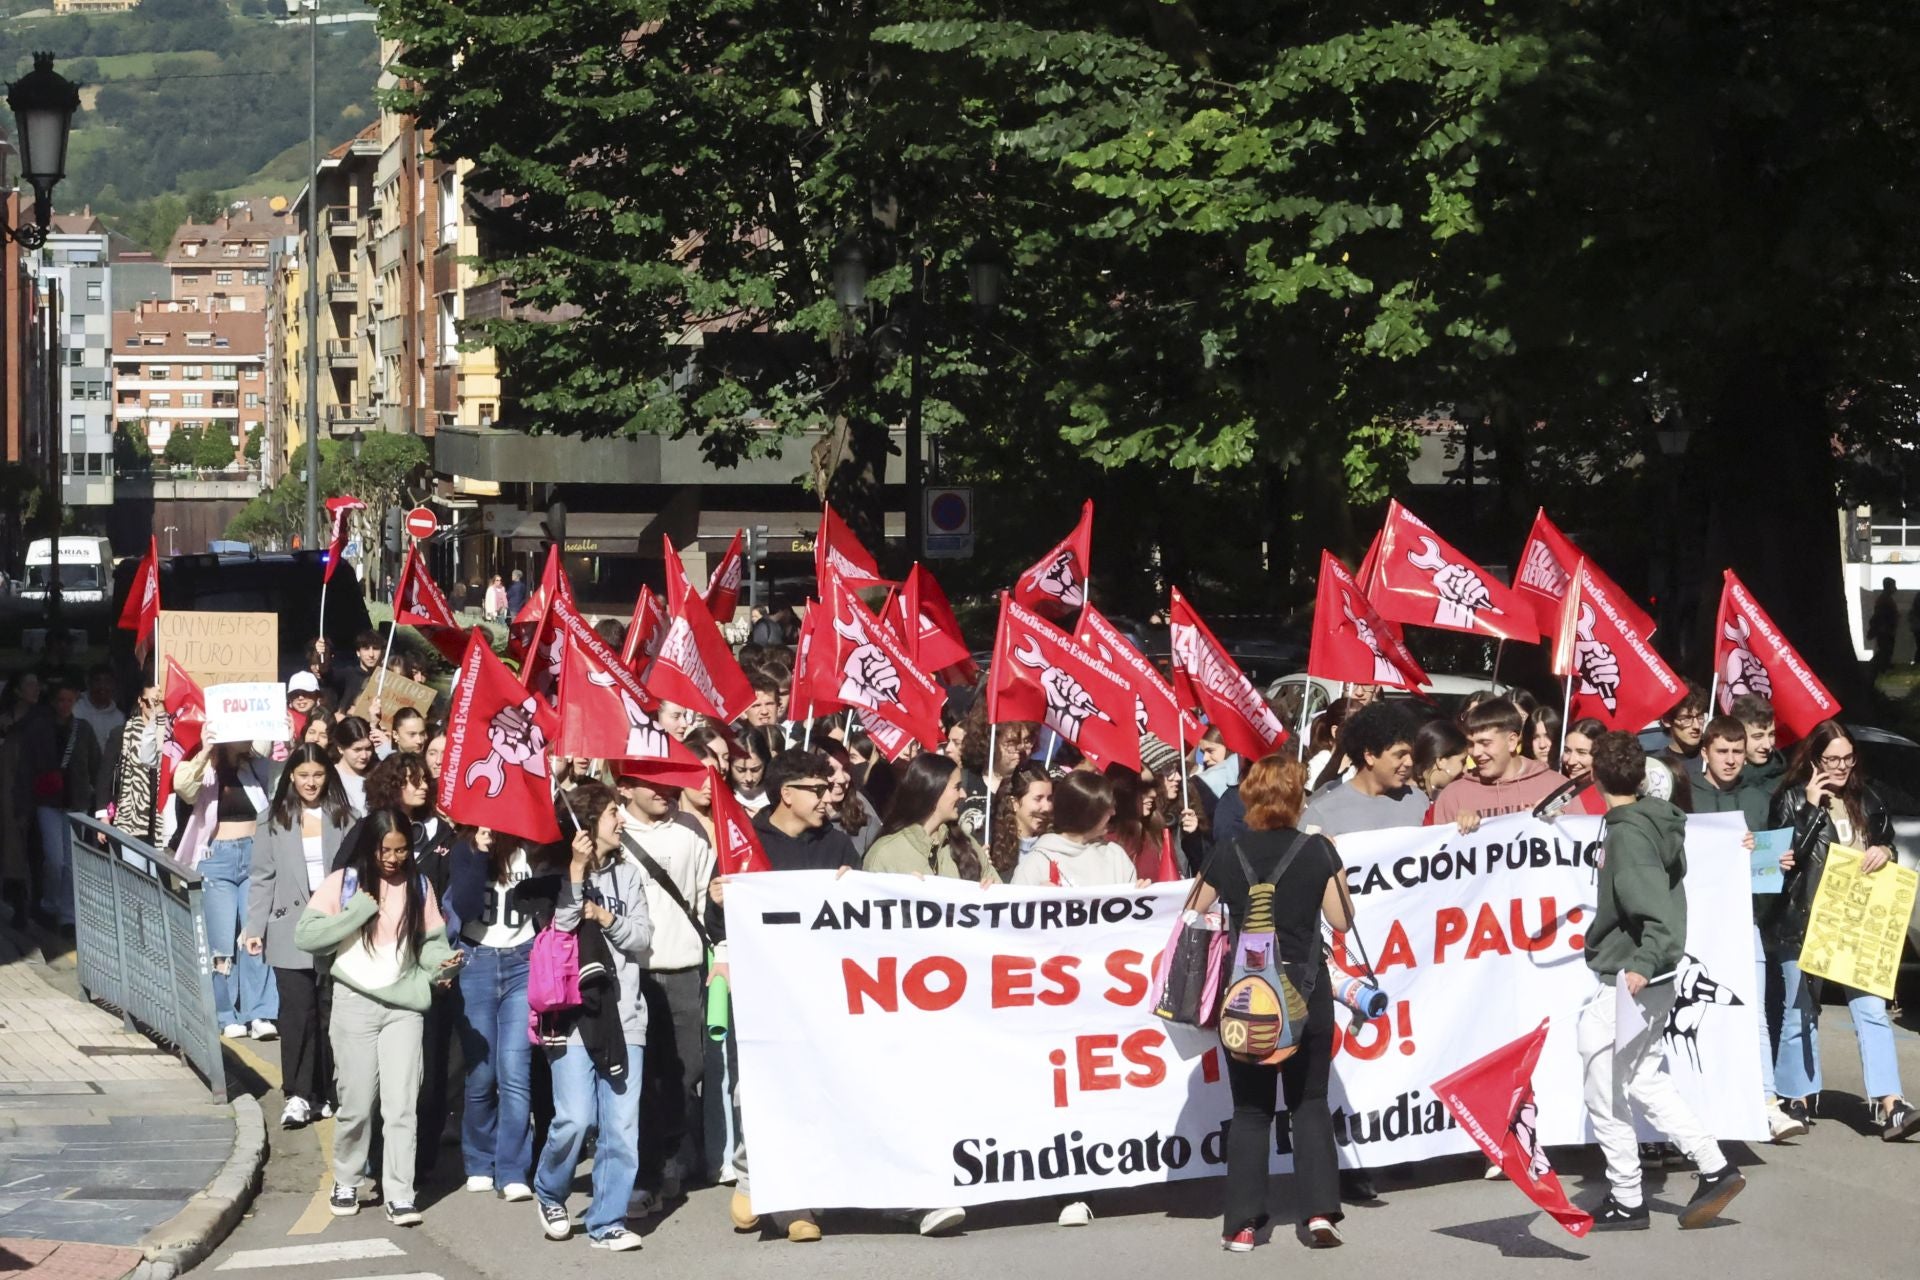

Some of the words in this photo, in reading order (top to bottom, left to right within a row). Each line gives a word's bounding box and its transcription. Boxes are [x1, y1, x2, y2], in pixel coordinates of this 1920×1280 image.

[161, 613, 194, 638] CON
[197, 616, 272, 638] NUESTRO
[163, 639, 234, 667] FUTURO
[240, 641, 273, 667] NO
[552, 599, 593, 648] Sindicato
[590, 639, 603, 655] de
[600, 649, 650, 704] Estudiantes
[1007, 601, 1061, 646] Sindicato
[1056, 634, 1072, 652] de
[1069, 643, 1131, 691] Estudiantes
[1086, 612, 1133, 661] Sindicato
[1130, 655, 1147, 674] de
[1612, 611, 1629, 635] de
[1625, 630, 1679, 695] Estudiantes
[1730, 583, 1772, 639] Sindicato
[1767, 632, 1784, 654] de
[1777, 647, 1831, 711] Estudiantes
[454, 644, 482, 724] Estudiantes
[881, 634, 937, 695] Estudiantes
[222, 697, 271, 713] PAUTAS
[452, 723, 468, 745] de
[440, 743, 464, 809] Sindicato
[811, 895, 1159, 931] ANTIDISTURBIOS
[842, 954, 968, 1015] NO
[991, 954, 1081, 1009] ES
[1048, 1028, 1167, 1108] ¡ES
[953, 1129, 1192, 1187] Sindicato
[1448, 1093, 1506, 1164] studiantes
